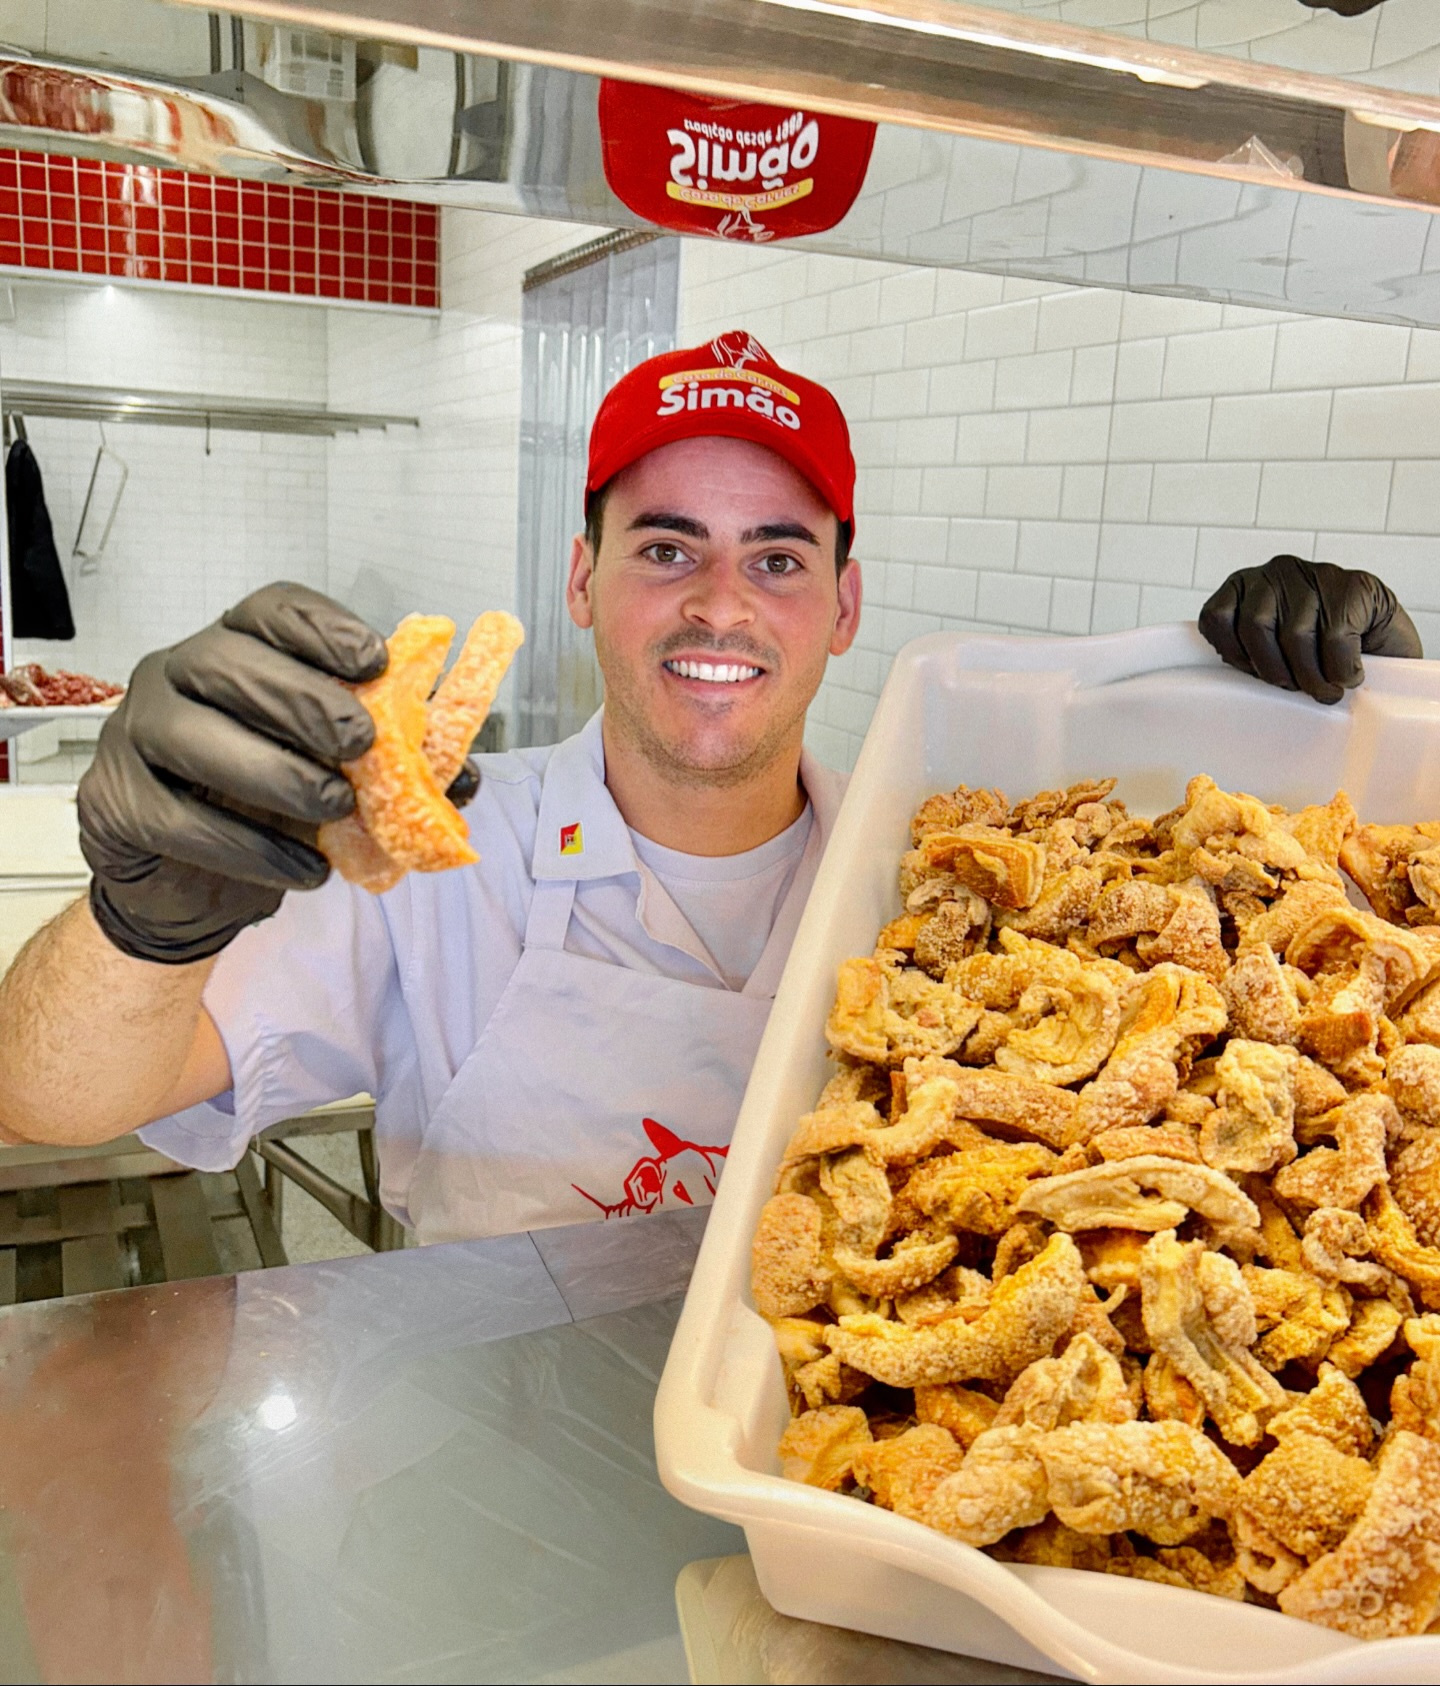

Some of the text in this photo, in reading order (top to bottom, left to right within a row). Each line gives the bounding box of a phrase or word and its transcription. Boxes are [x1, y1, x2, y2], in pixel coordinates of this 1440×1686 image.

[673, 369, 789, 396] Casa de Carnes
[656, 382, 801, 431] Simão
